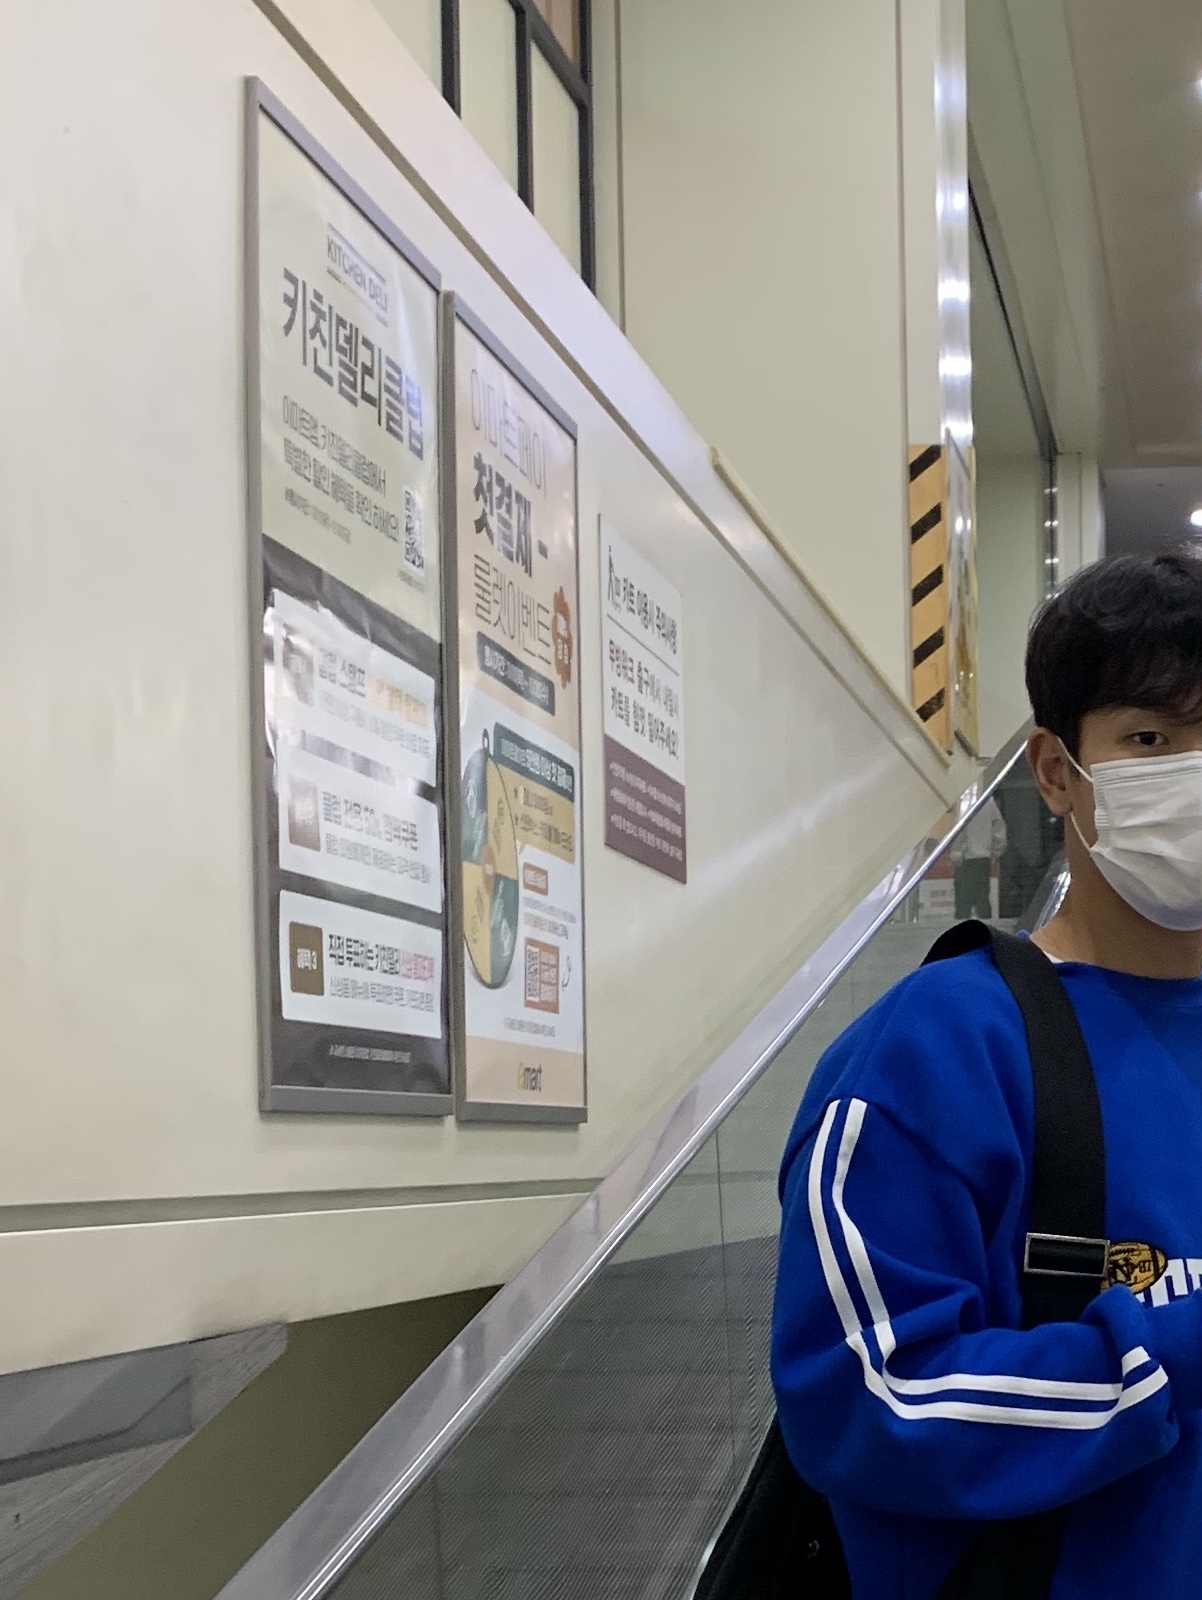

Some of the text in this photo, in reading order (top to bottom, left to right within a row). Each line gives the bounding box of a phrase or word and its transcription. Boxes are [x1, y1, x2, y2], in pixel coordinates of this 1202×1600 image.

[327, 235, 388, 314] KITCHEN DELI
[283, 267, 423, 461] 키친델리클럽
[471, 368, 547, 497] 이마트페이
[473, 451, 532, 578] 첫결제
[474, 554, 551, 664] 룰렛이벤트
